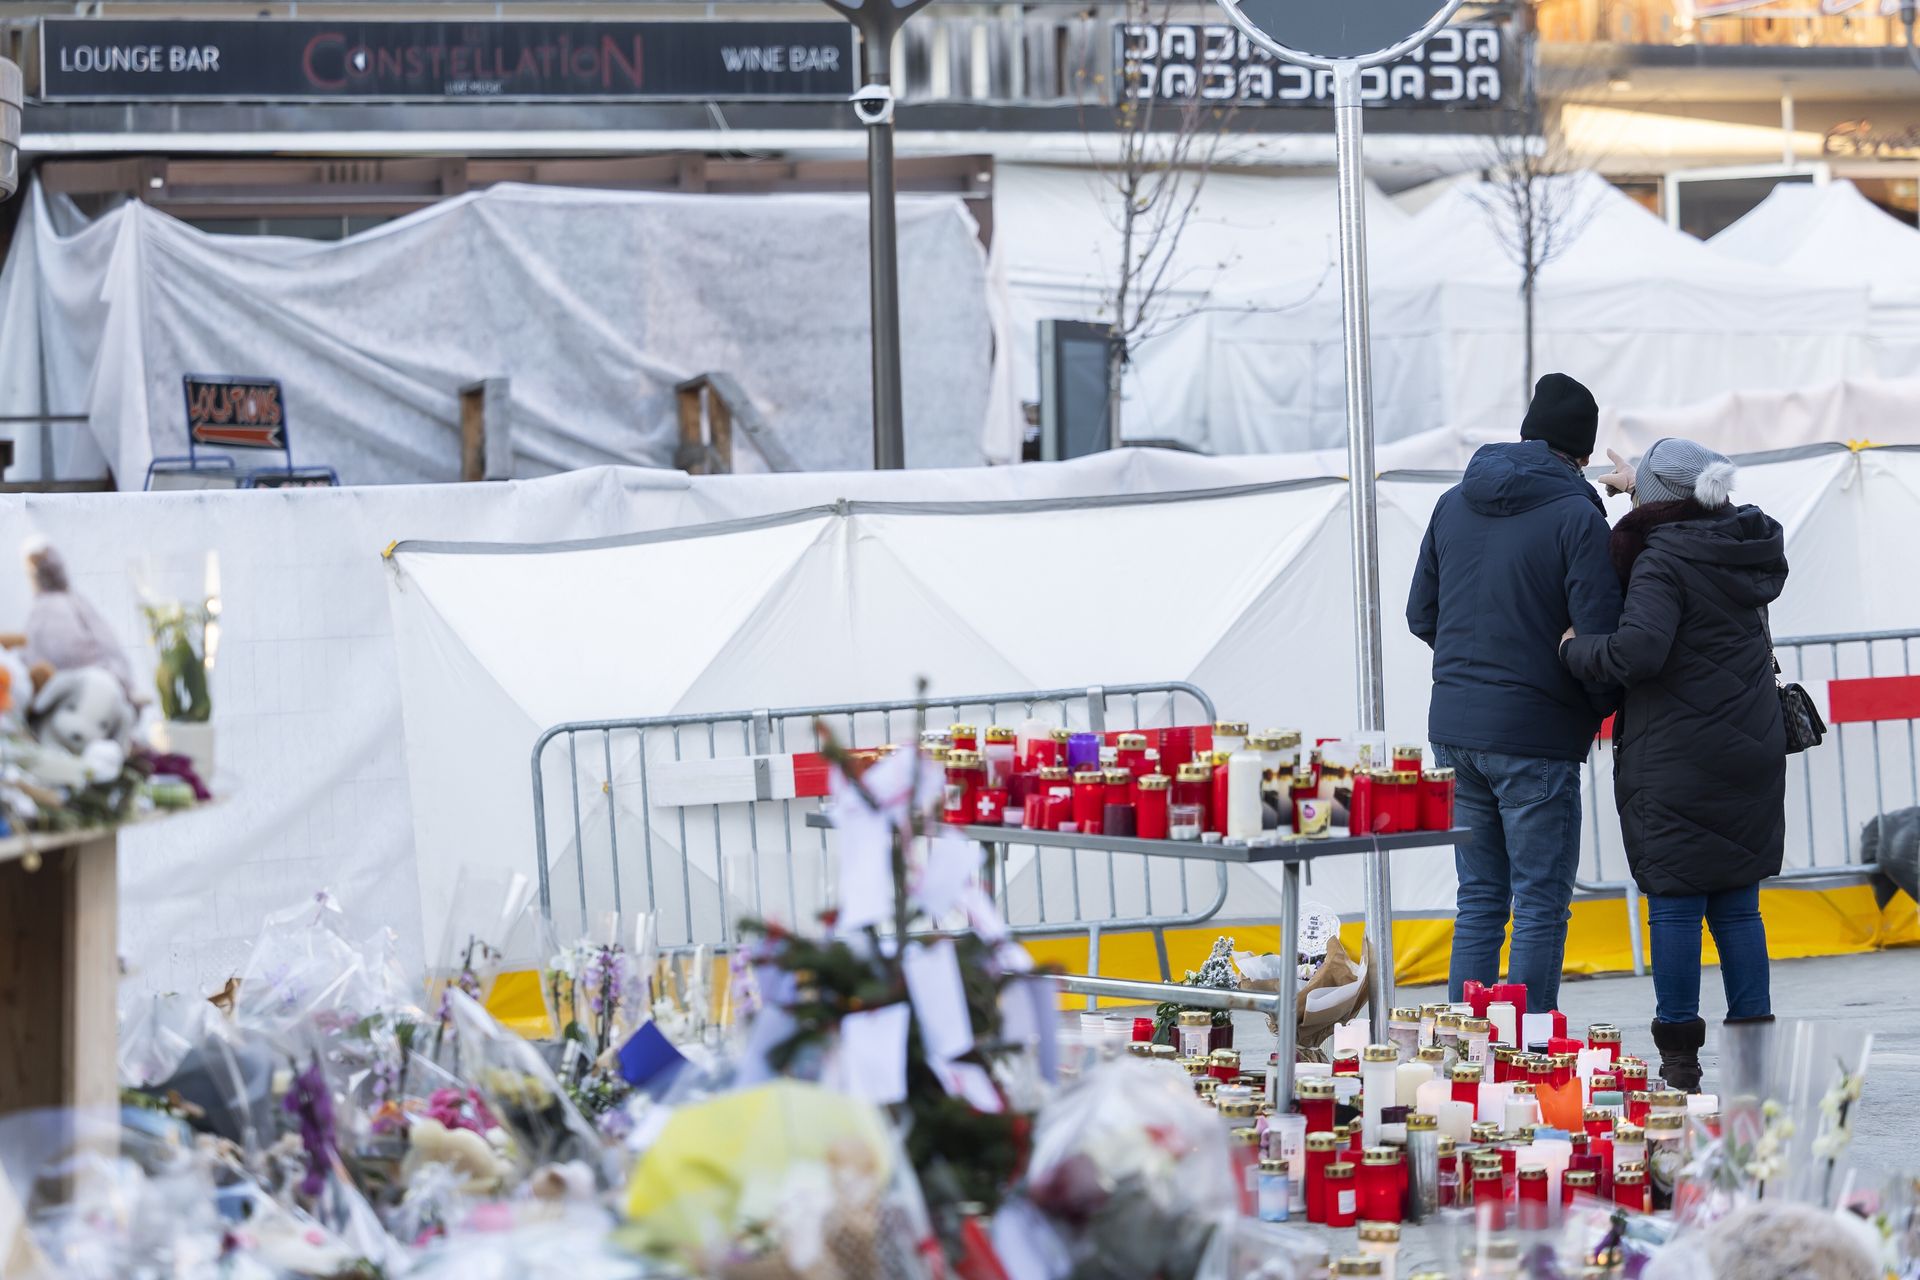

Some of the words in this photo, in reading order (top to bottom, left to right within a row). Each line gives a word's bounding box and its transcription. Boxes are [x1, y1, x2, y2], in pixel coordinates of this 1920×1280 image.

[60, 45, 164, 72] LOUNGE
[169, 46, 220, 72] BAR
[720, 46, 786, 72] WINE
[788, 46, 840, 72] BAR
